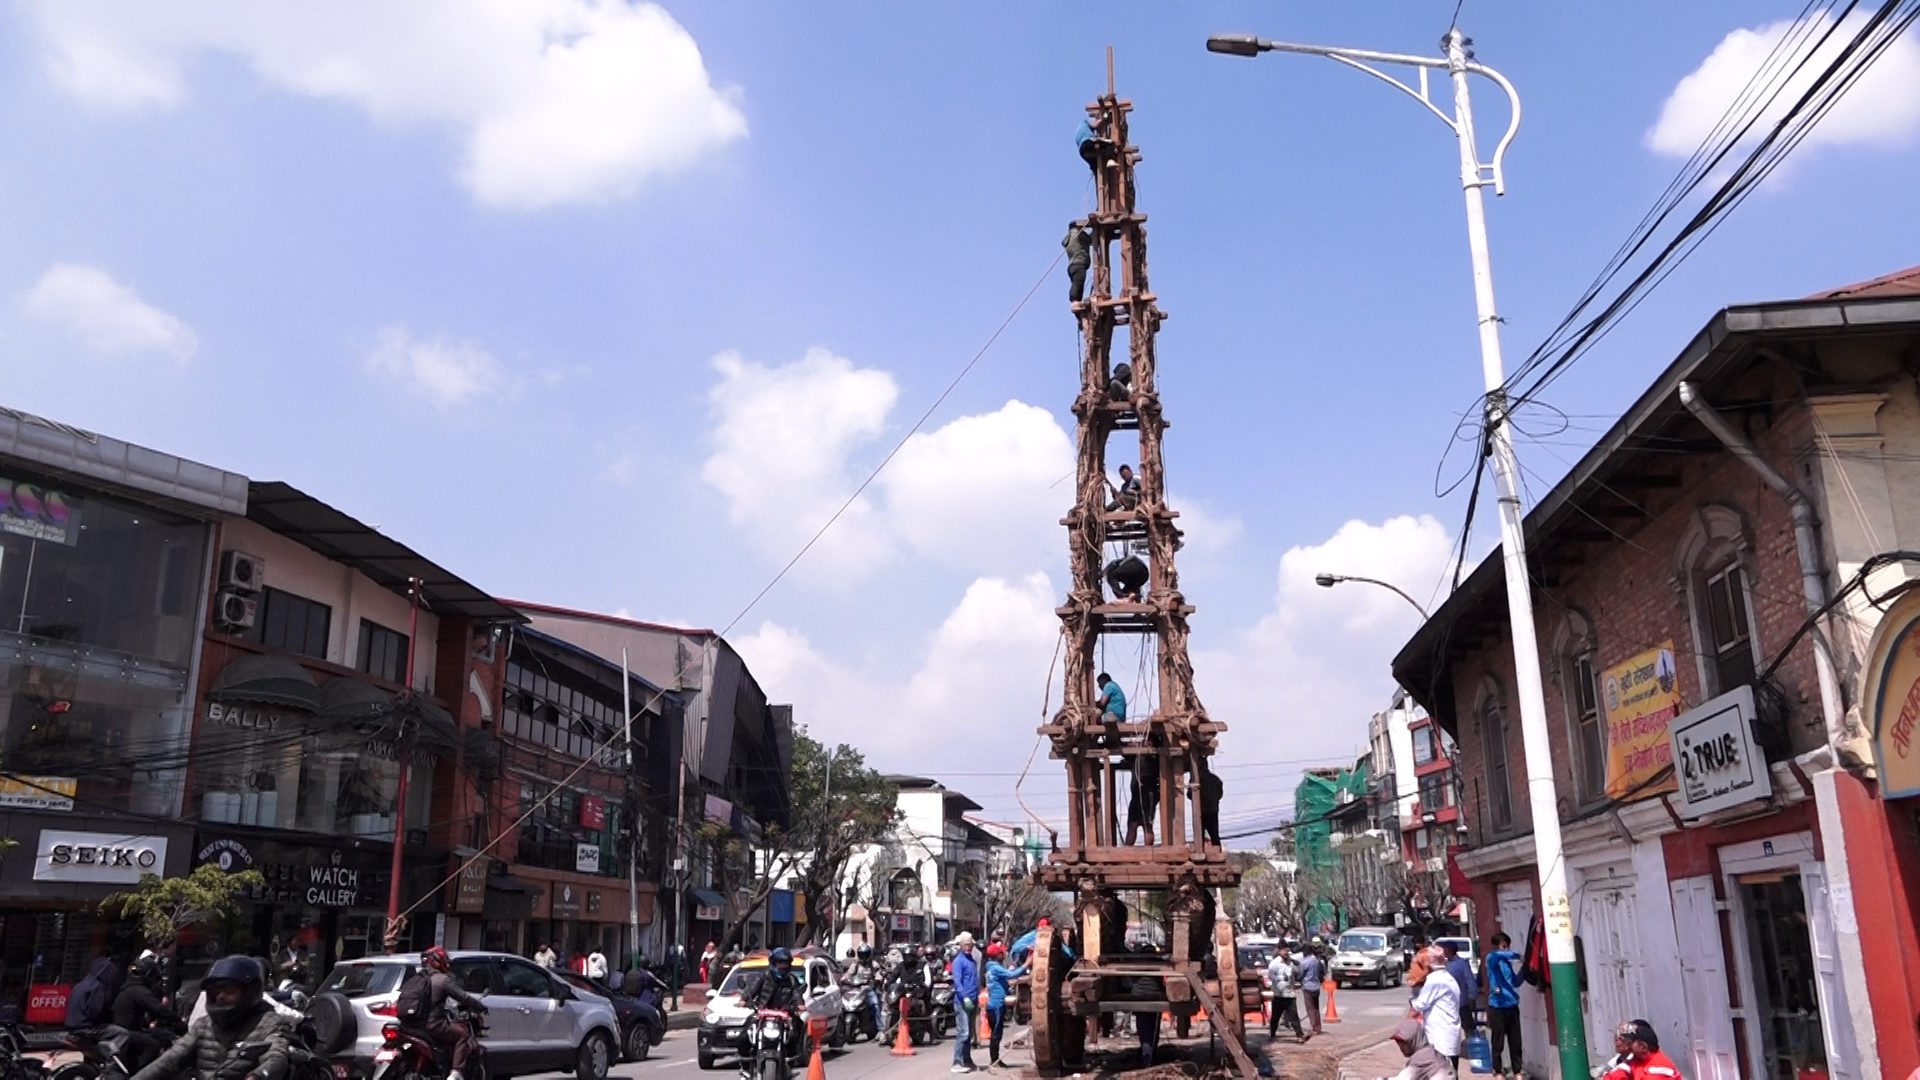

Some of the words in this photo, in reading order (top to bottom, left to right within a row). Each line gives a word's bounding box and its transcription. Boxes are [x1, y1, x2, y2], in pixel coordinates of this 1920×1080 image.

[208, 702, 281, 733] BALLY
[50, 844, 156, 868] SEIKO
[310, 865, 358, 887] WATCH
[306, 887, 358, 907] GALLERY
[31, 996, 66, 1008] OFFER
